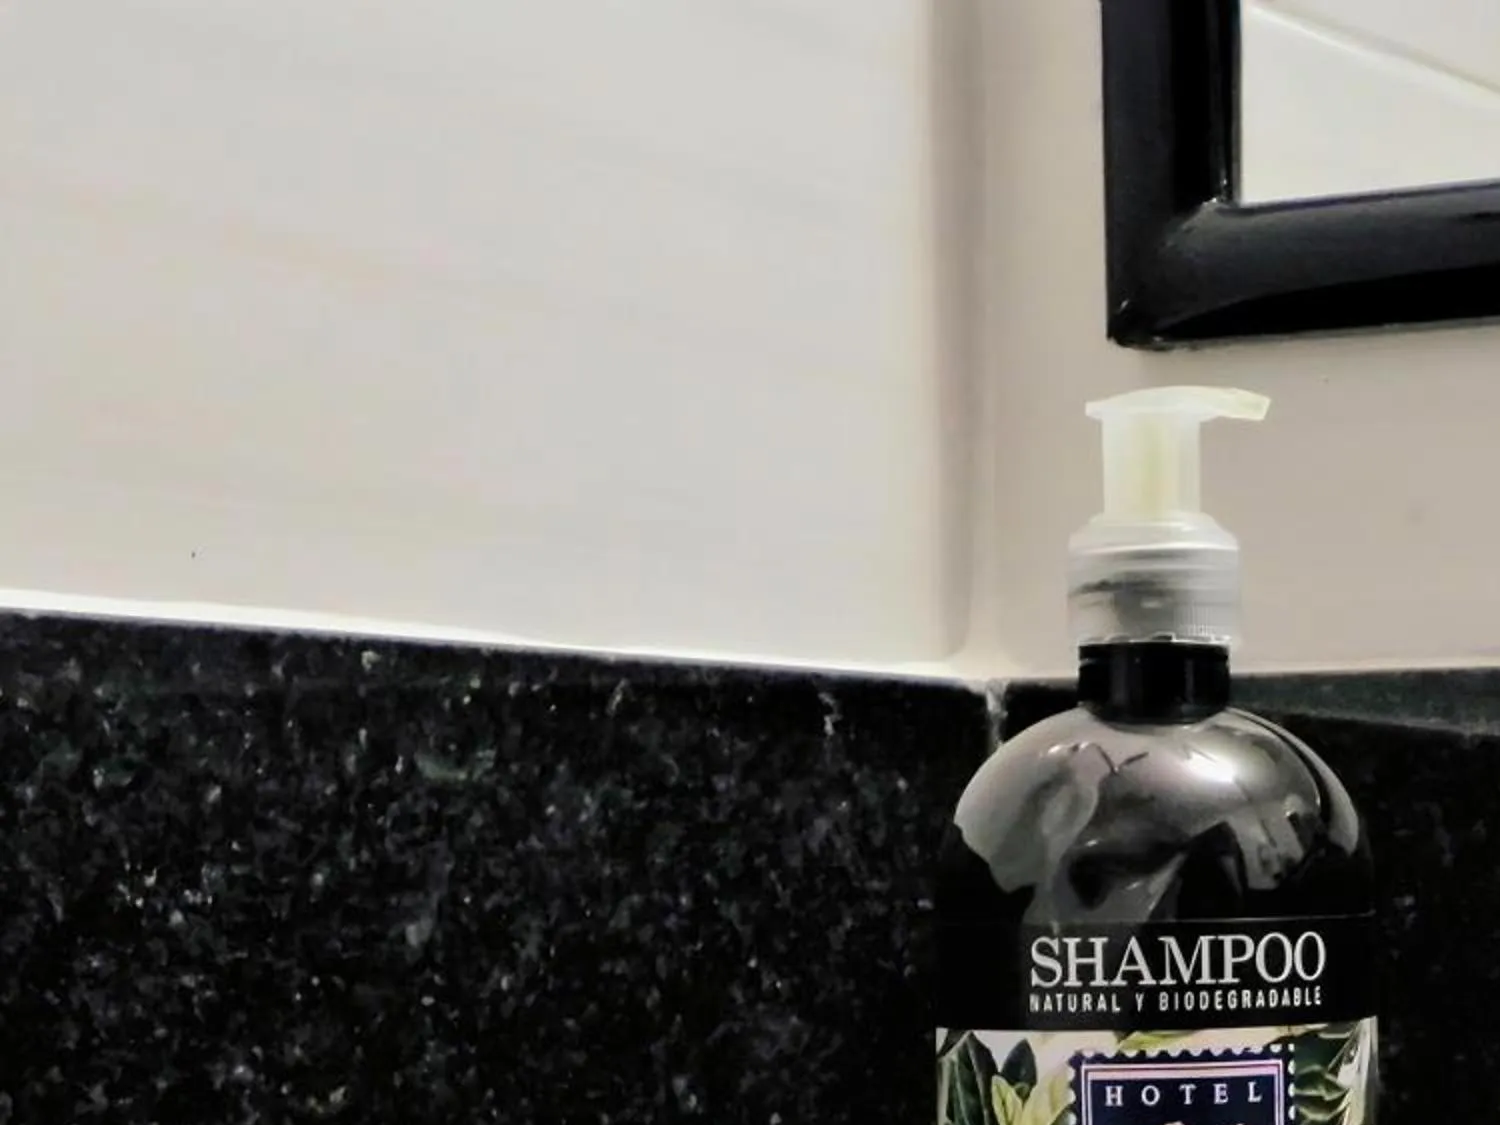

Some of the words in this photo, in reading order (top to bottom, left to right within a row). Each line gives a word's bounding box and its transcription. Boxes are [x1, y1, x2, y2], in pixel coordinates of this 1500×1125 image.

[1030, 932, 1326, 988] SHAMPOO
[1029, 992, 1121, 1013] NATURAL
[1136, 993, 1145, 1012] Y
[1159, 986, 1322, 1011] BIODEGRADABLE
[1105, 1081, 1263, 1107] HOTEL
